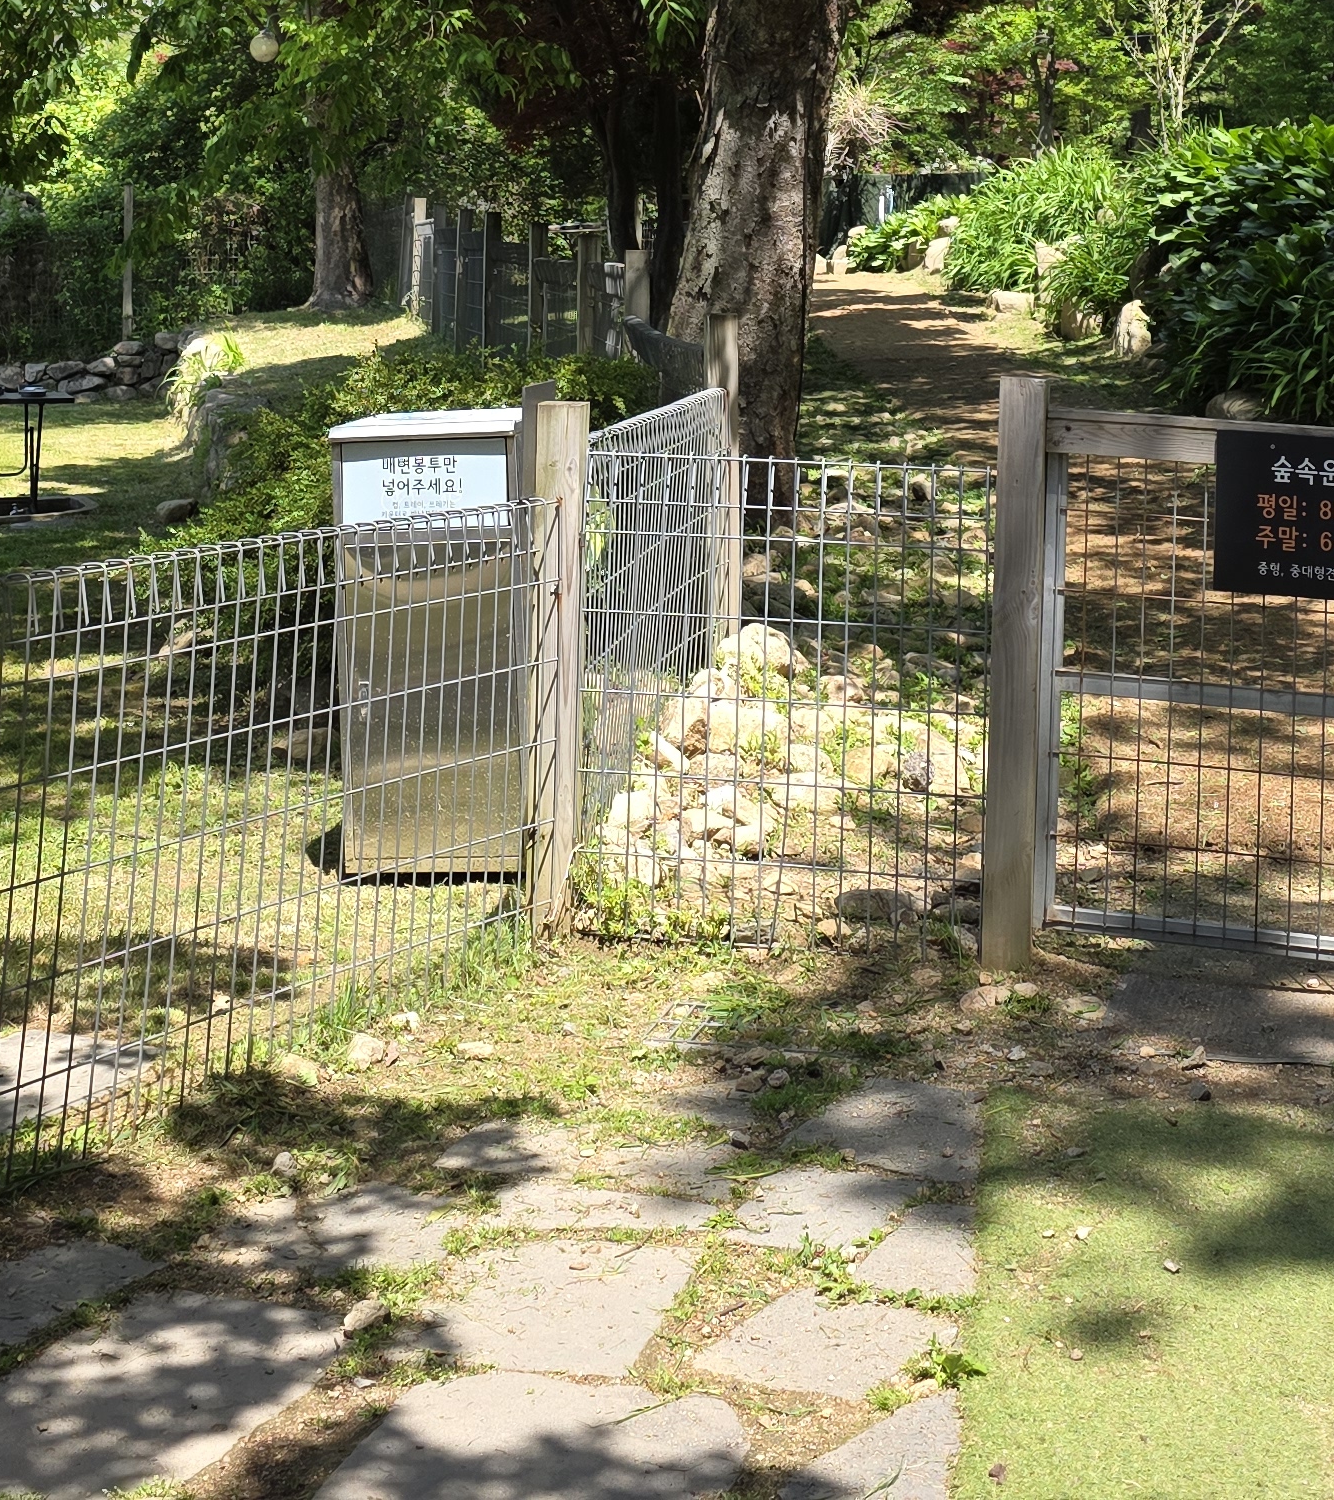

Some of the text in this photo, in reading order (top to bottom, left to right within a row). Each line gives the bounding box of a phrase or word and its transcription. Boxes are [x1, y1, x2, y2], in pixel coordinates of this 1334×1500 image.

[382, 477, 463, 497] 넣어주세요!
[1256, 493, 1307, 521] 평일:
[1255, 525, 1308, 552] 주말:
[1257, 561, 1284, 577] 중형,
